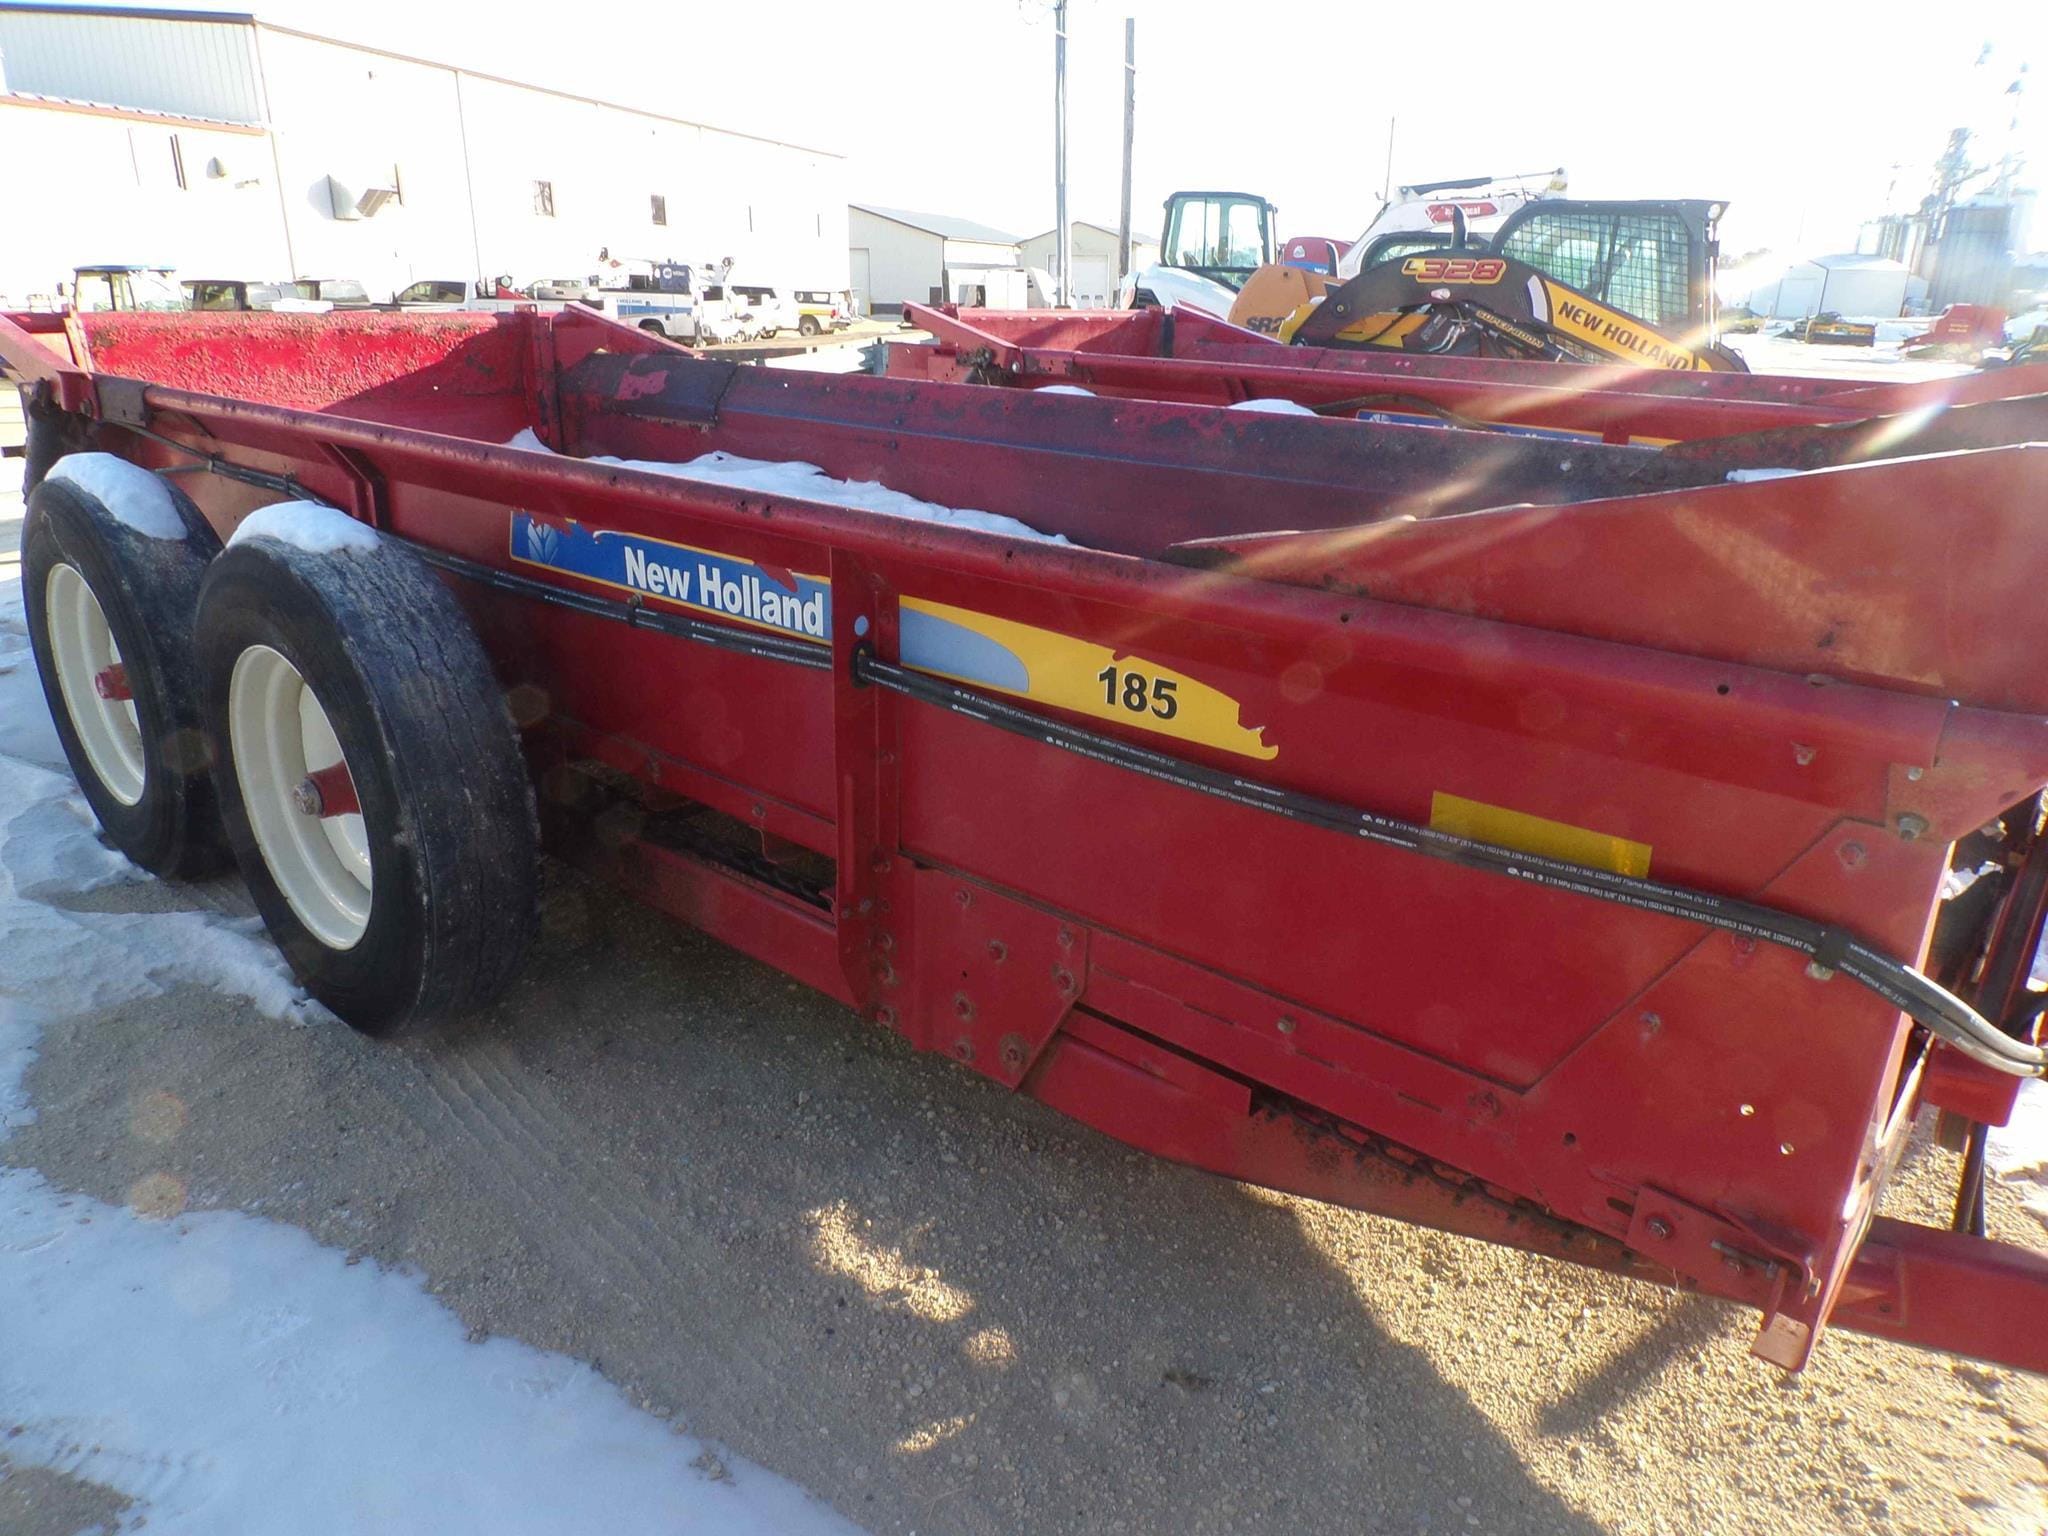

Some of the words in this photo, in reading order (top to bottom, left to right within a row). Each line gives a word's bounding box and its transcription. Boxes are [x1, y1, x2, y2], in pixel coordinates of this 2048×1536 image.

[1558, 301, 1603, 332] NEW
[1601, 323, 1689, 369] HOLLAND
[624, 546, 690, 600] New
[698, 564, 824, 637] Holland
[1098, 664, 1177, 721] 185
